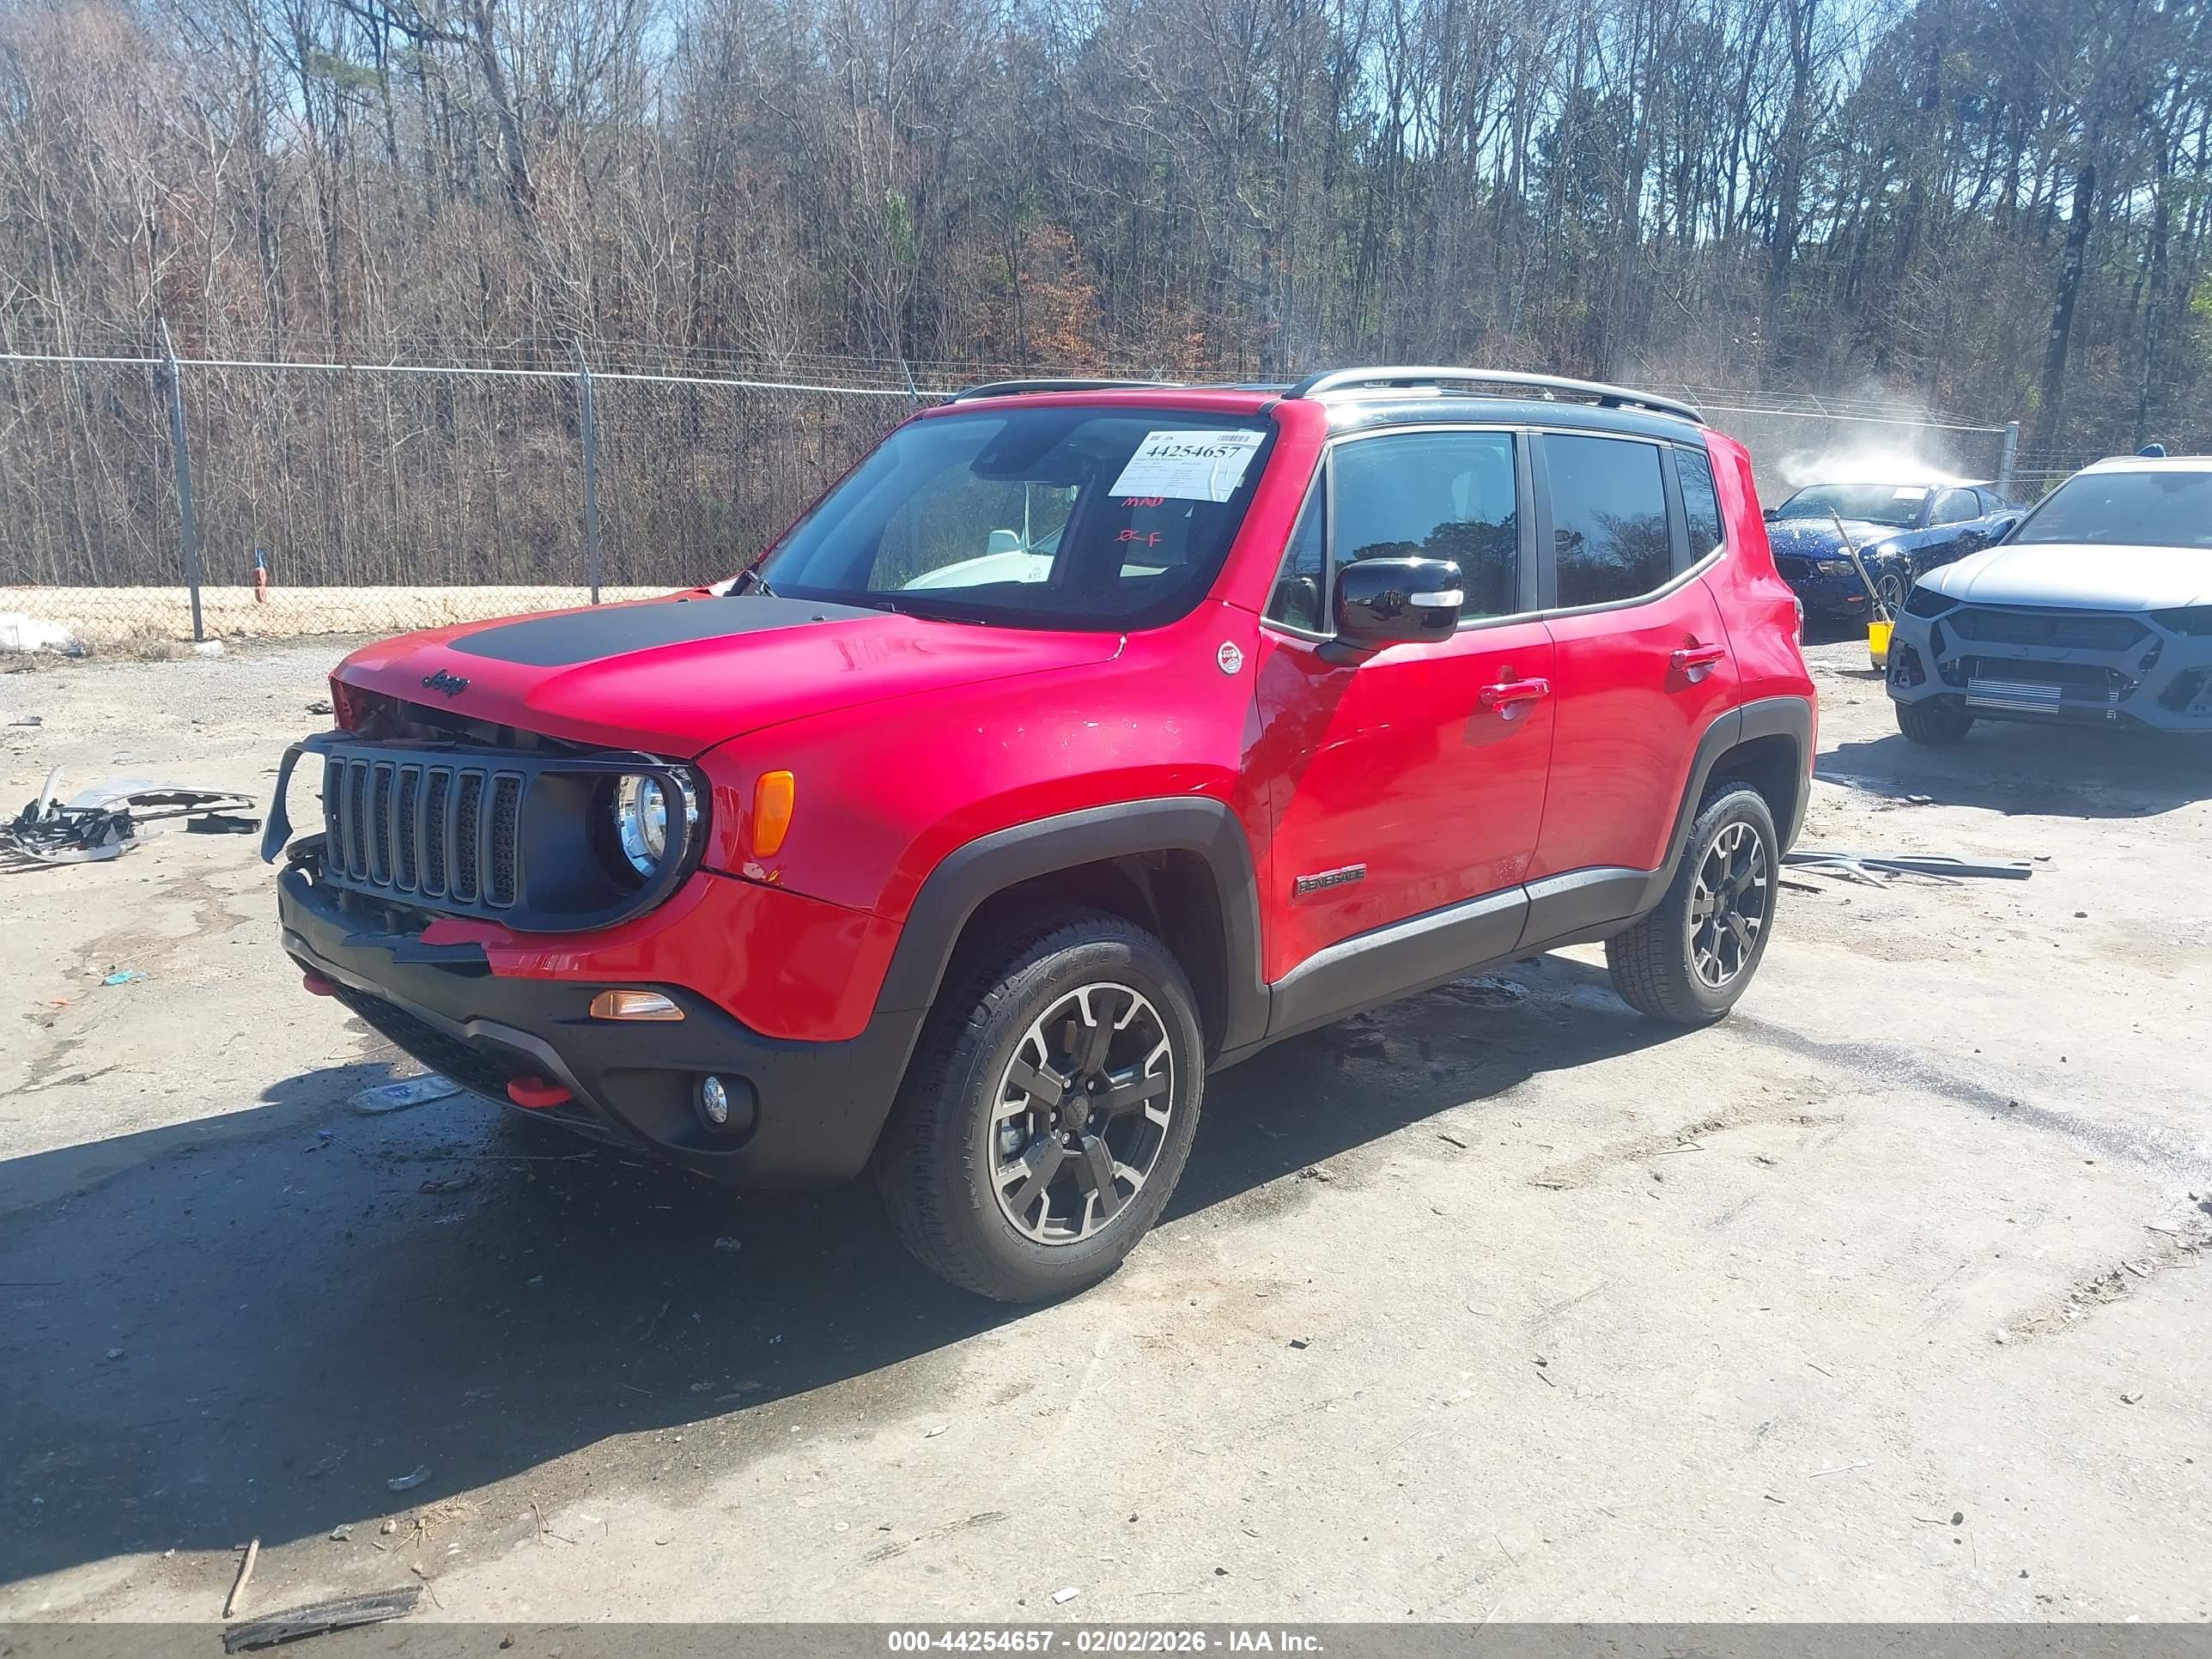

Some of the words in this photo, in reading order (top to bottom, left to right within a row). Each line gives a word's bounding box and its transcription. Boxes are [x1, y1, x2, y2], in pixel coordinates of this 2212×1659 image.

[1146, 445, 1242, 459] 44254657
[422, 668, 471, 699] Jeep
[1296, 863, 1367, 896] RENEGADE
